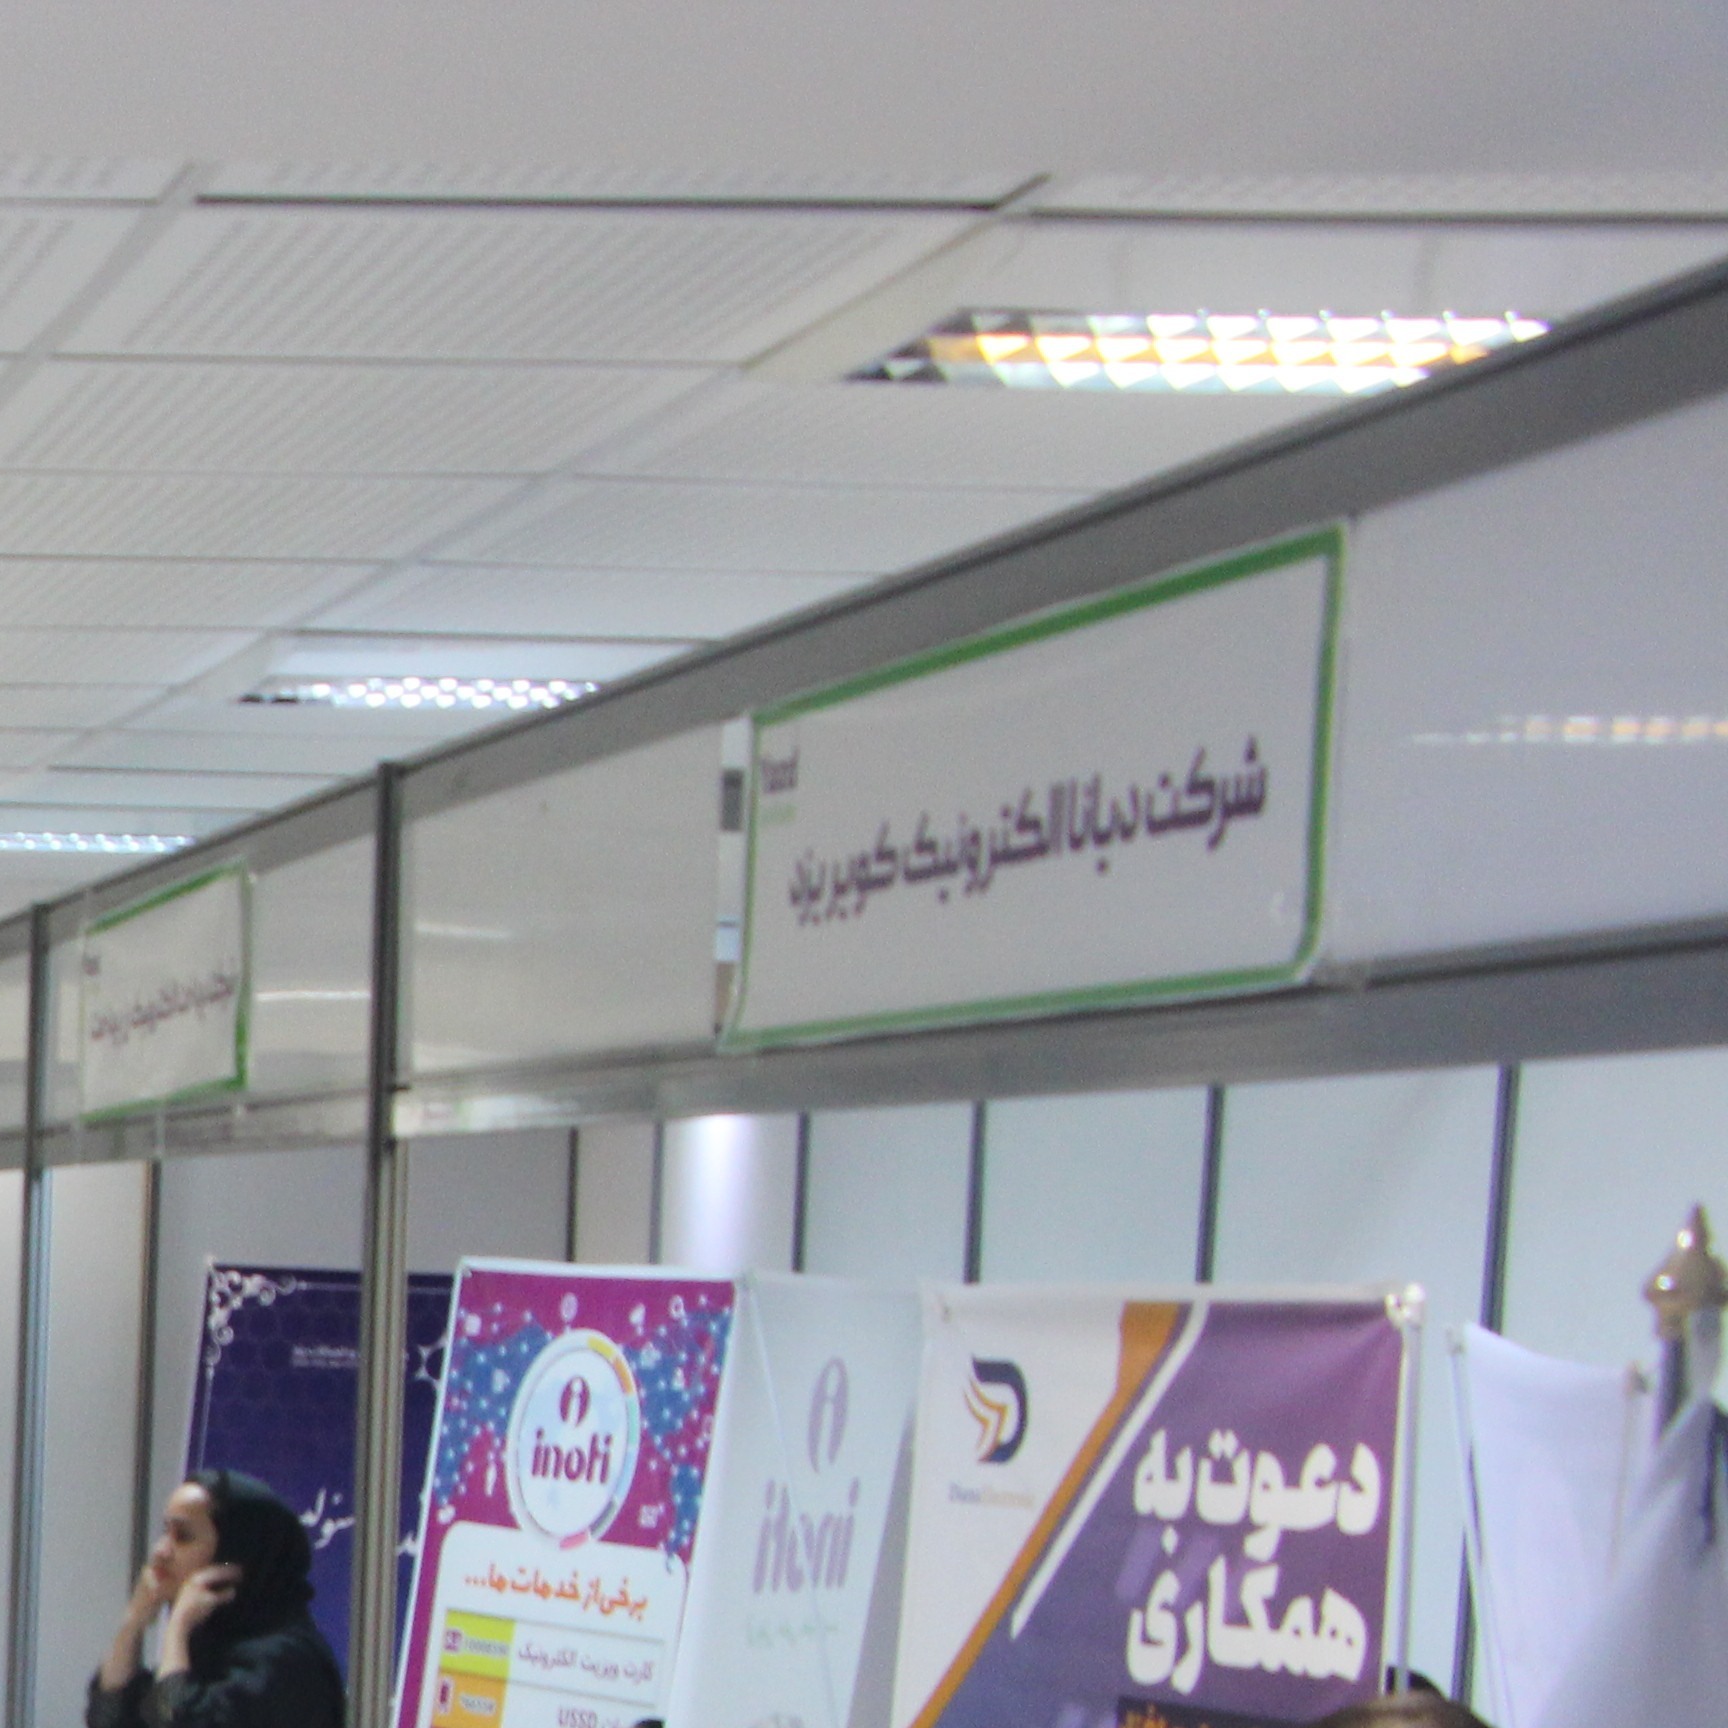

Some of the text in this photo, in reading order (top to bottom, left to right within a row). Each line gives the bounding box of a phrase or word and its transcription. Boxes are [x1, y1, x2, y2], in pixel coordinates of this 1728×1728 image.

[1145, 733, 1269, 852] شرکت
[1133, 1427, 1383, 1562] دعوت به
[1126, 1554, 1369, 1695] همکاری
